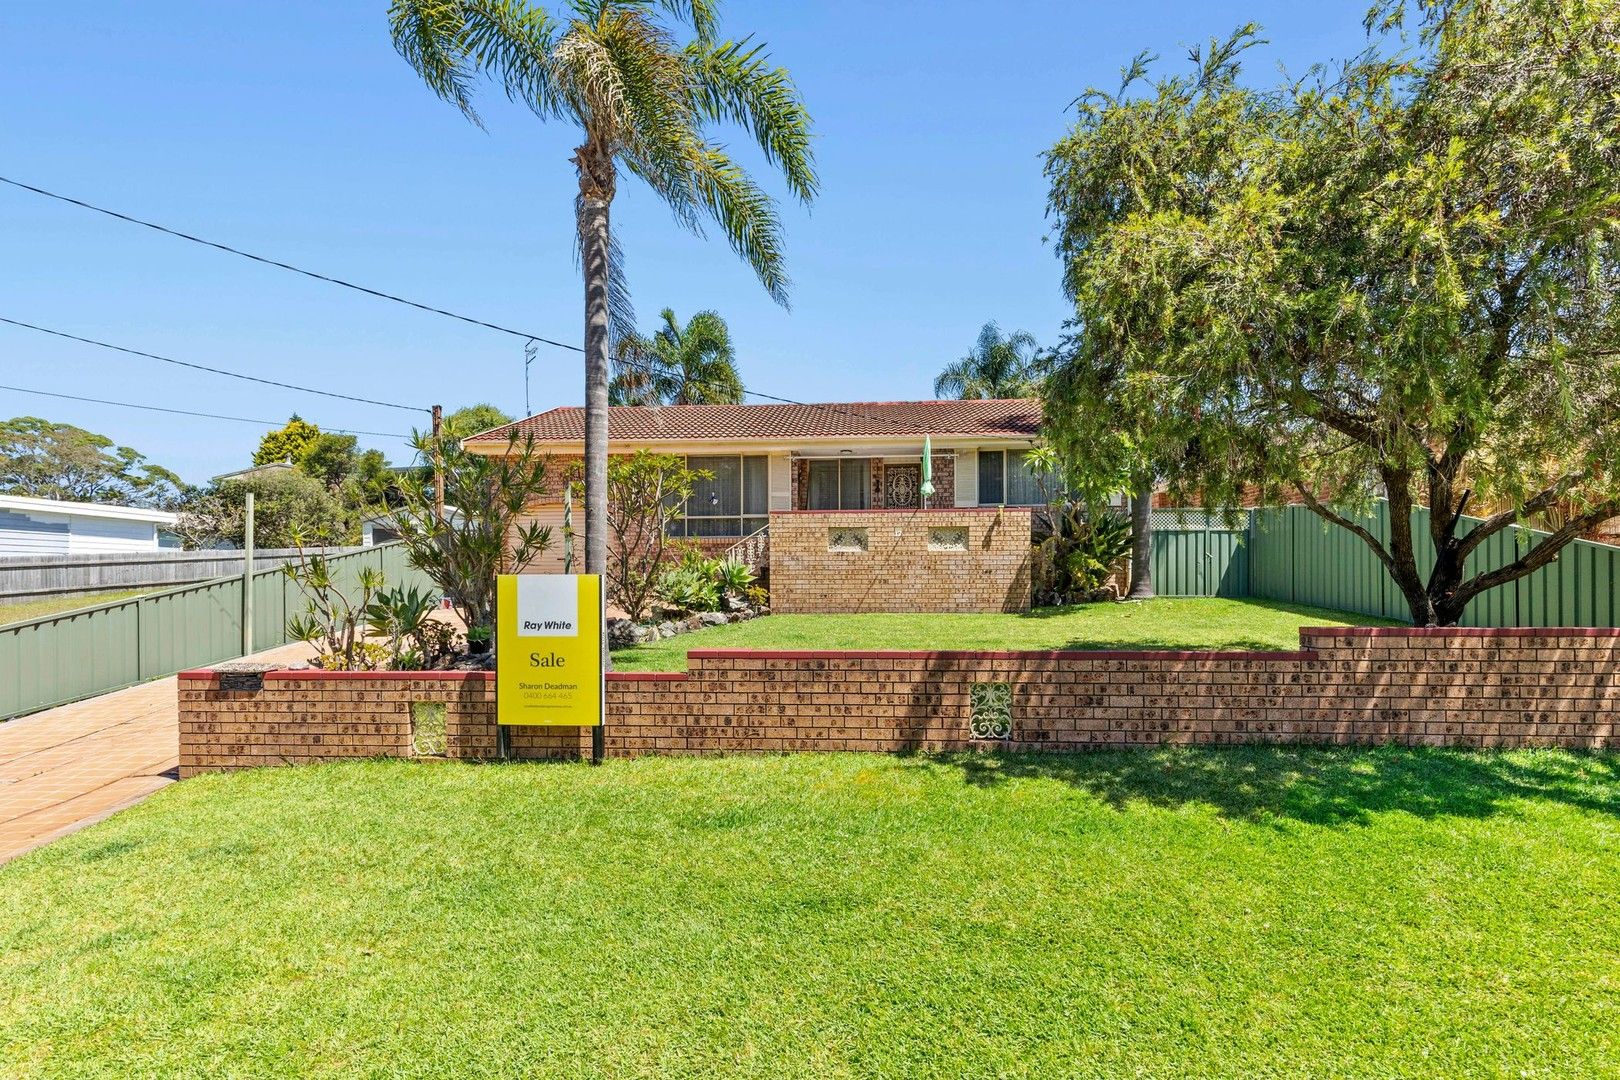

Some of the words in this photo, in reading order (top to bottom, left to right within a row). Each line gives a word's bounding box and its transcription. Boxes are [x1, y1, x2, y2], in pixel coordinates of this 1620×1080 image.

[524, 621, 542, 631] Ray
[544, 621, 572, 630] White
[530, 652, 565, 668] Sale
[519, 682, 542, 690] Sharon
[544, 682, 577, 690] Deadman
[523, 692, 542, 700] 0400
